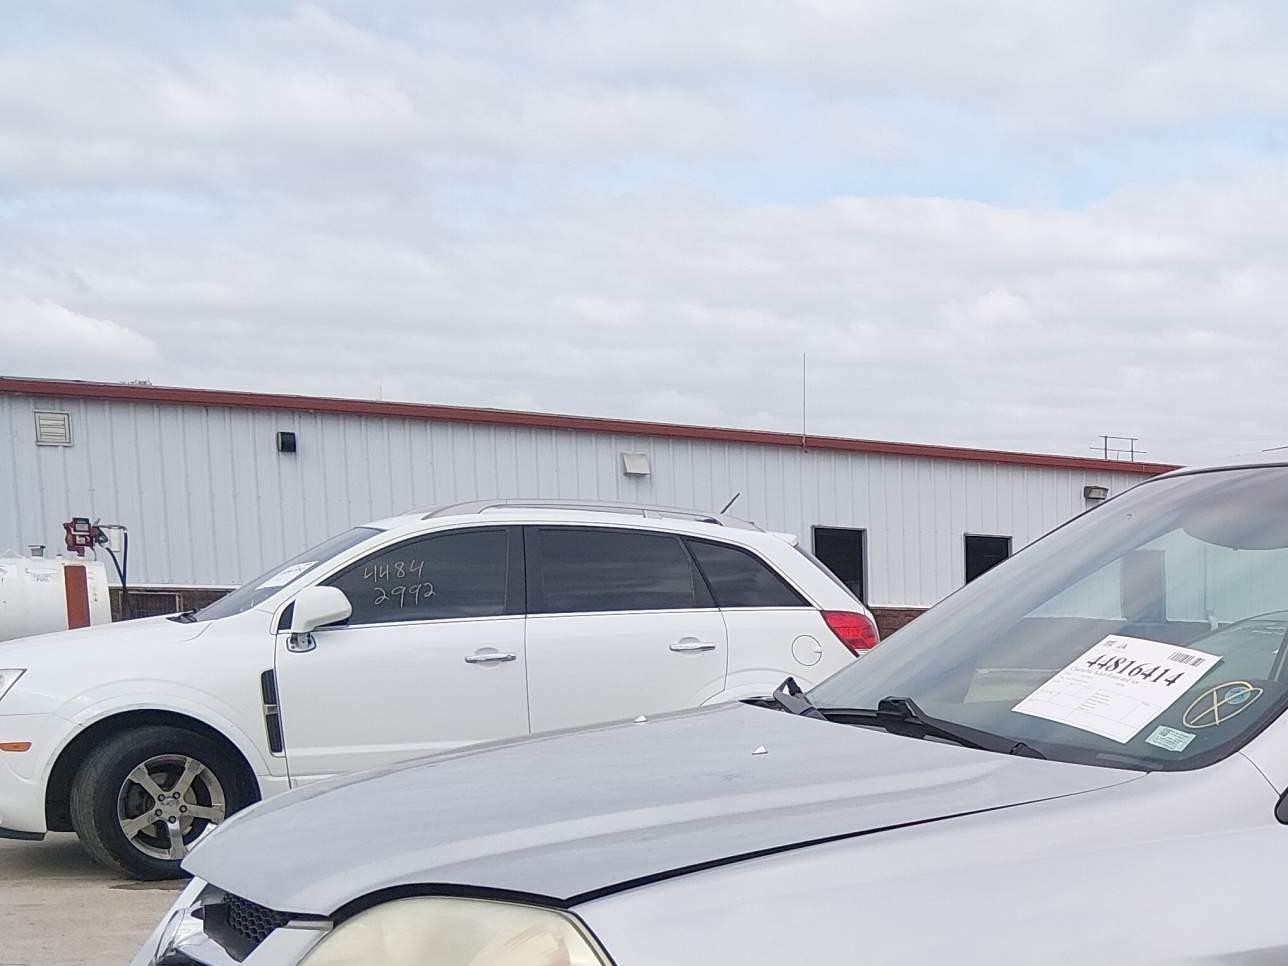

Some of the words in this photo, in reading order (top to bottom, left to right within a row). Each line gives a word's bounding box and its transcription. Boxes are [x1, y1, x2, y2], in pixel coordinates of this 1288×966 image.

[363, 560, 424, 582] 4484
[374, 582, 436, 608] 2992
[1087, 654, 1185, 687] 44816414
